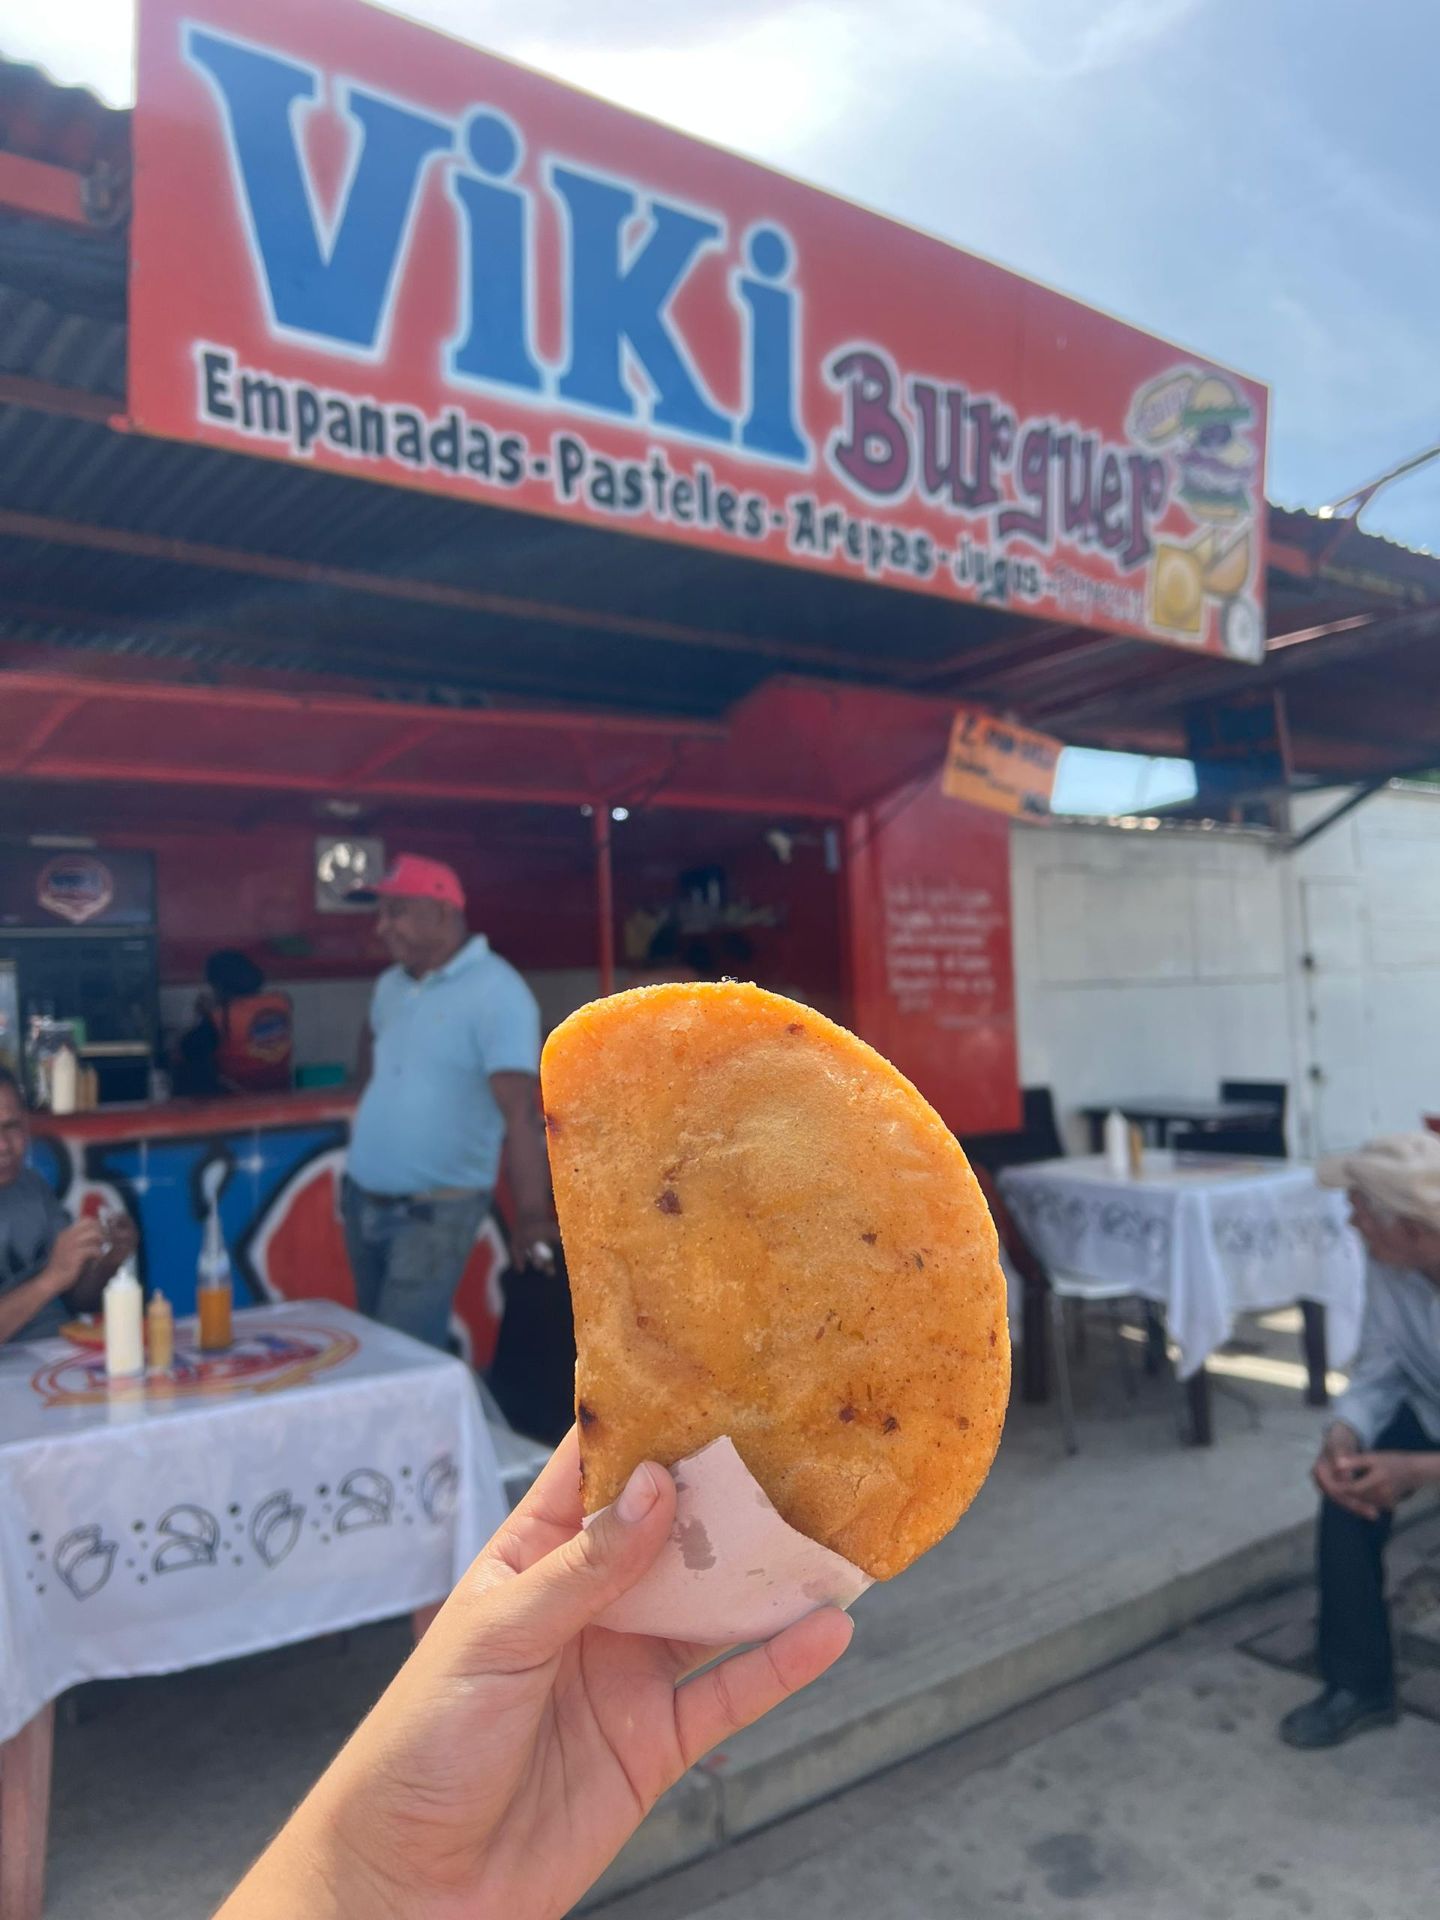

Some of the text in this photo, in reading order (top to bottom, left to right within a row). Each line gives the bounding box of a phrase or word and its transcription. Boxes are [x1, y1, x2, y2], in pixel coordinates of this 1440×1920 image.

[203, 351, 523, 483] Empanadas
[559, 437, 765, 538] Pasteles
[796, 499, 935, 574] Arepas
[832, 350, 1167, 567] Burguer
